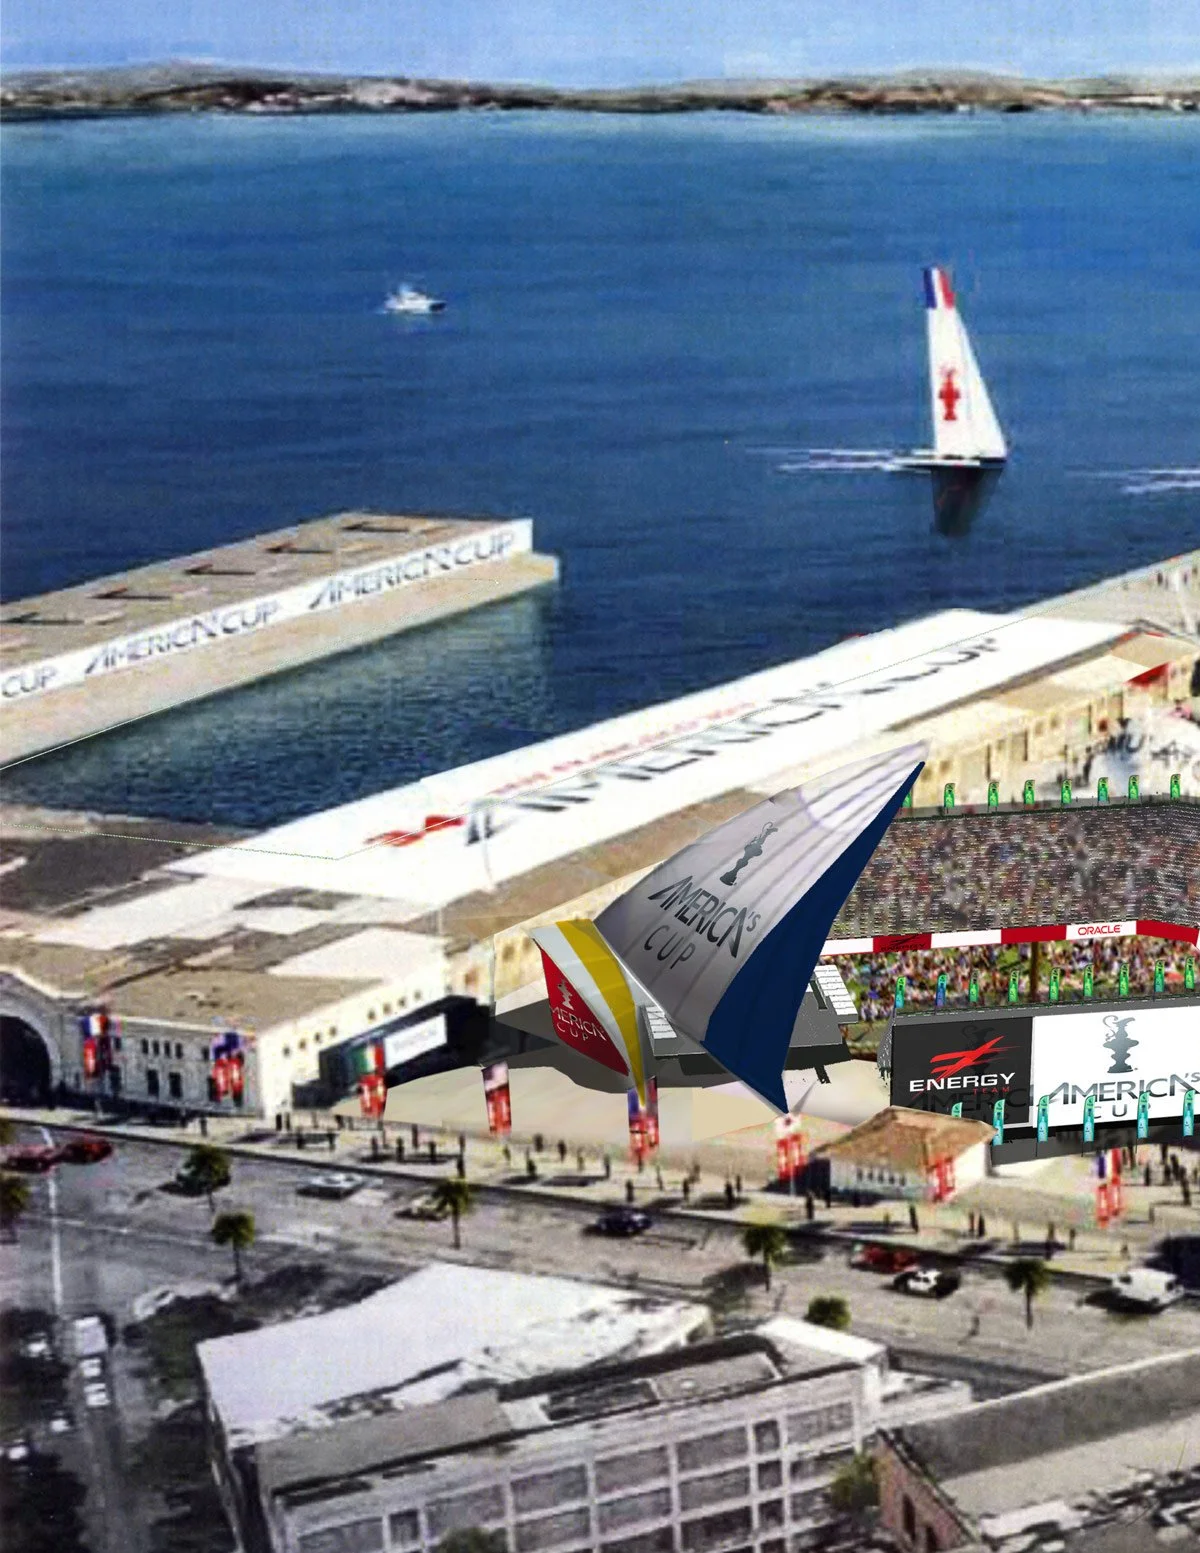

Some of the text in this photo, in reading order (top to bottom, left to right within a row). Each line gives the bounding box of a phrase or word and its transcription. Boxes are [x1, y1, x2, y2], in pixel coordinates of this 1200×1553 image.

[1077, 924, 1122, 936] ORACLE
[643, 925, 696, 970] CUP
[909, 1072, 1016, 1092] ENERGY
[973, 1086, 1011, 1096] TEAM
